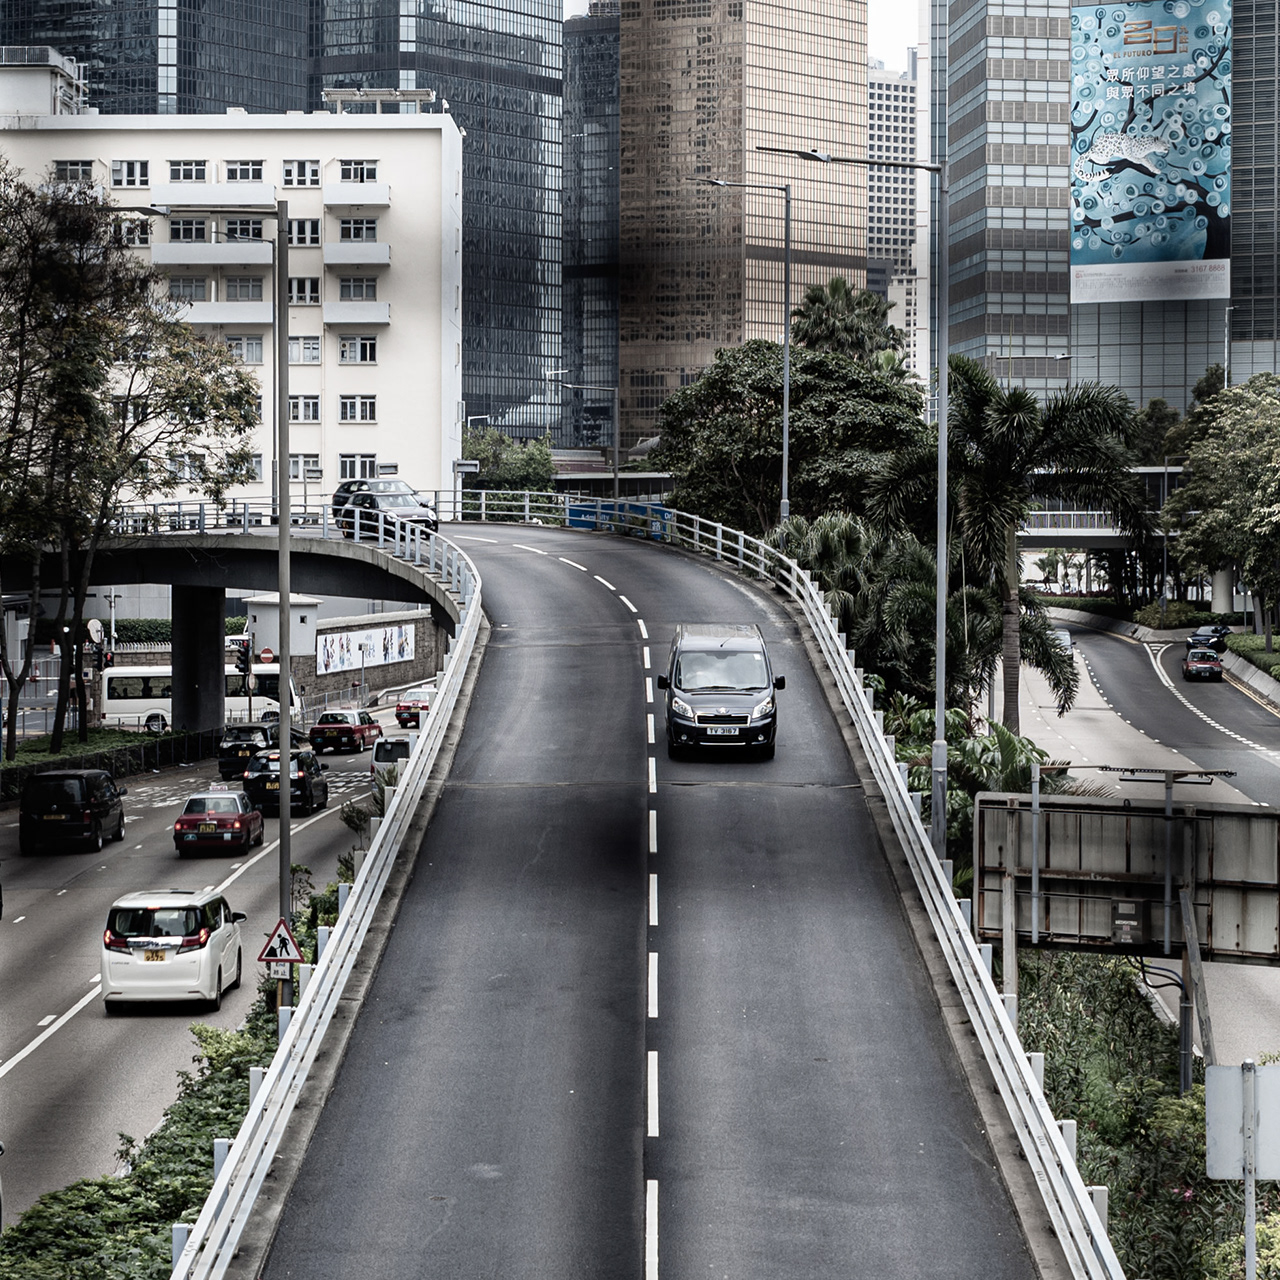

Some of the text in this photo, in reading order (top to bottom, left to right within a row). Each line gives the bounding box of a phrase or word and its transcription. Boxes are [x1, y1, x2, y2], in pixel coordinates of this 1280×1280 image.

[1122, 50, 1152, 59] FUTURO
[1106, 63, 1197, 83] 眾所仰望之處
[1106, 81, 1197, 100] 與眾不同之境
